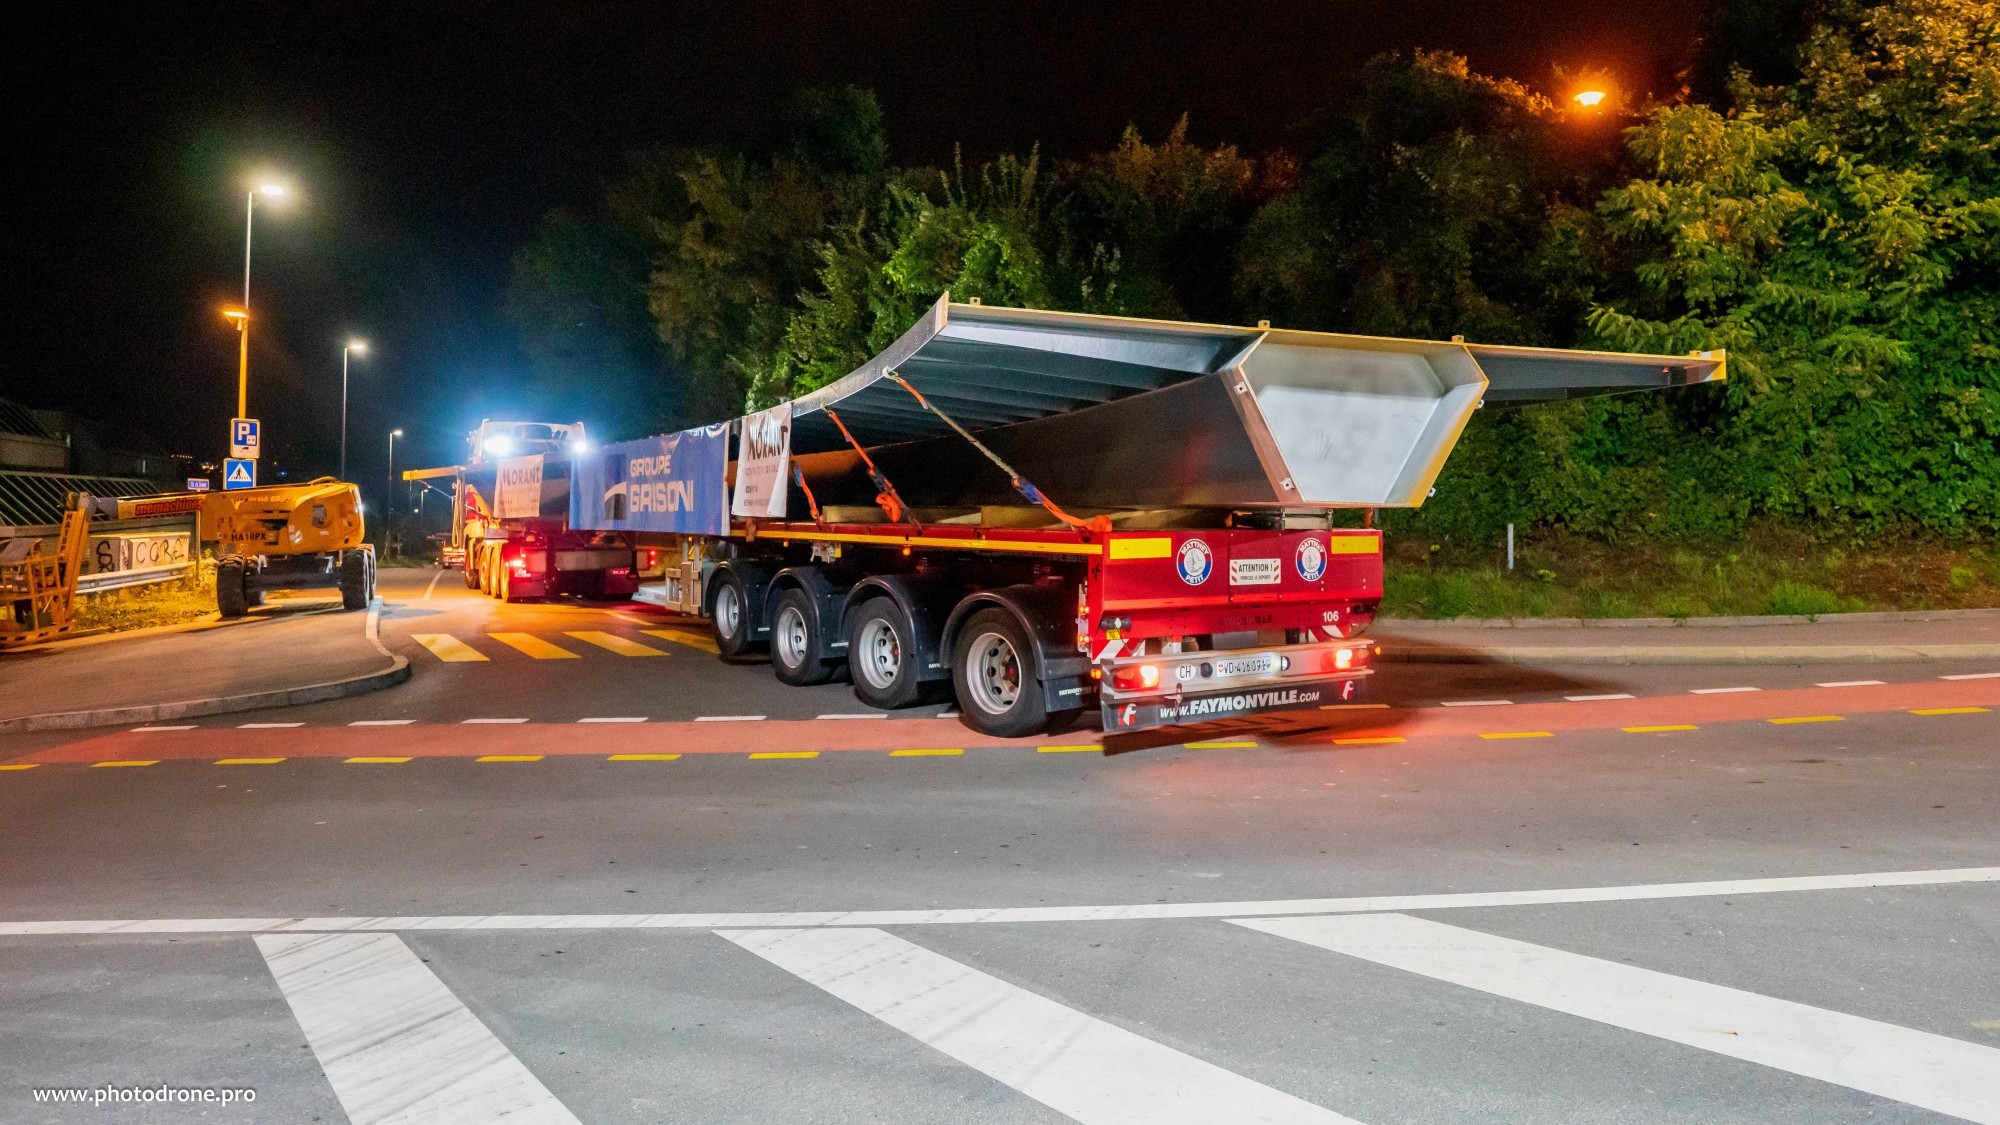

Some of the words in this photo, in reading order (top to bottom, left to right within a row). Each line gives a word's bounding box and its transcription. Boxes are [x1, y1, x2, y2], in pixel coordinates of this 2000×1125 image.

[237, 422, 251, 441] P
[630, 454, 671, 477] GROUPE
[630, 480, 693, 512] GRISONI
[231, 532, 266, 542] HA18PX
[1180, 540, 1210, 555] MATTHEY
[1300, 539, 1325, 553] MATTHEY
[1238, 563, 1269, 573] ATTENTION
[1303, 570, 1320, 580] PETIT
[1185, 573, 1204, 584] PETIT
[1322, 610, 1339, 623] 106
[1179, 665, 1191, 679] CH
